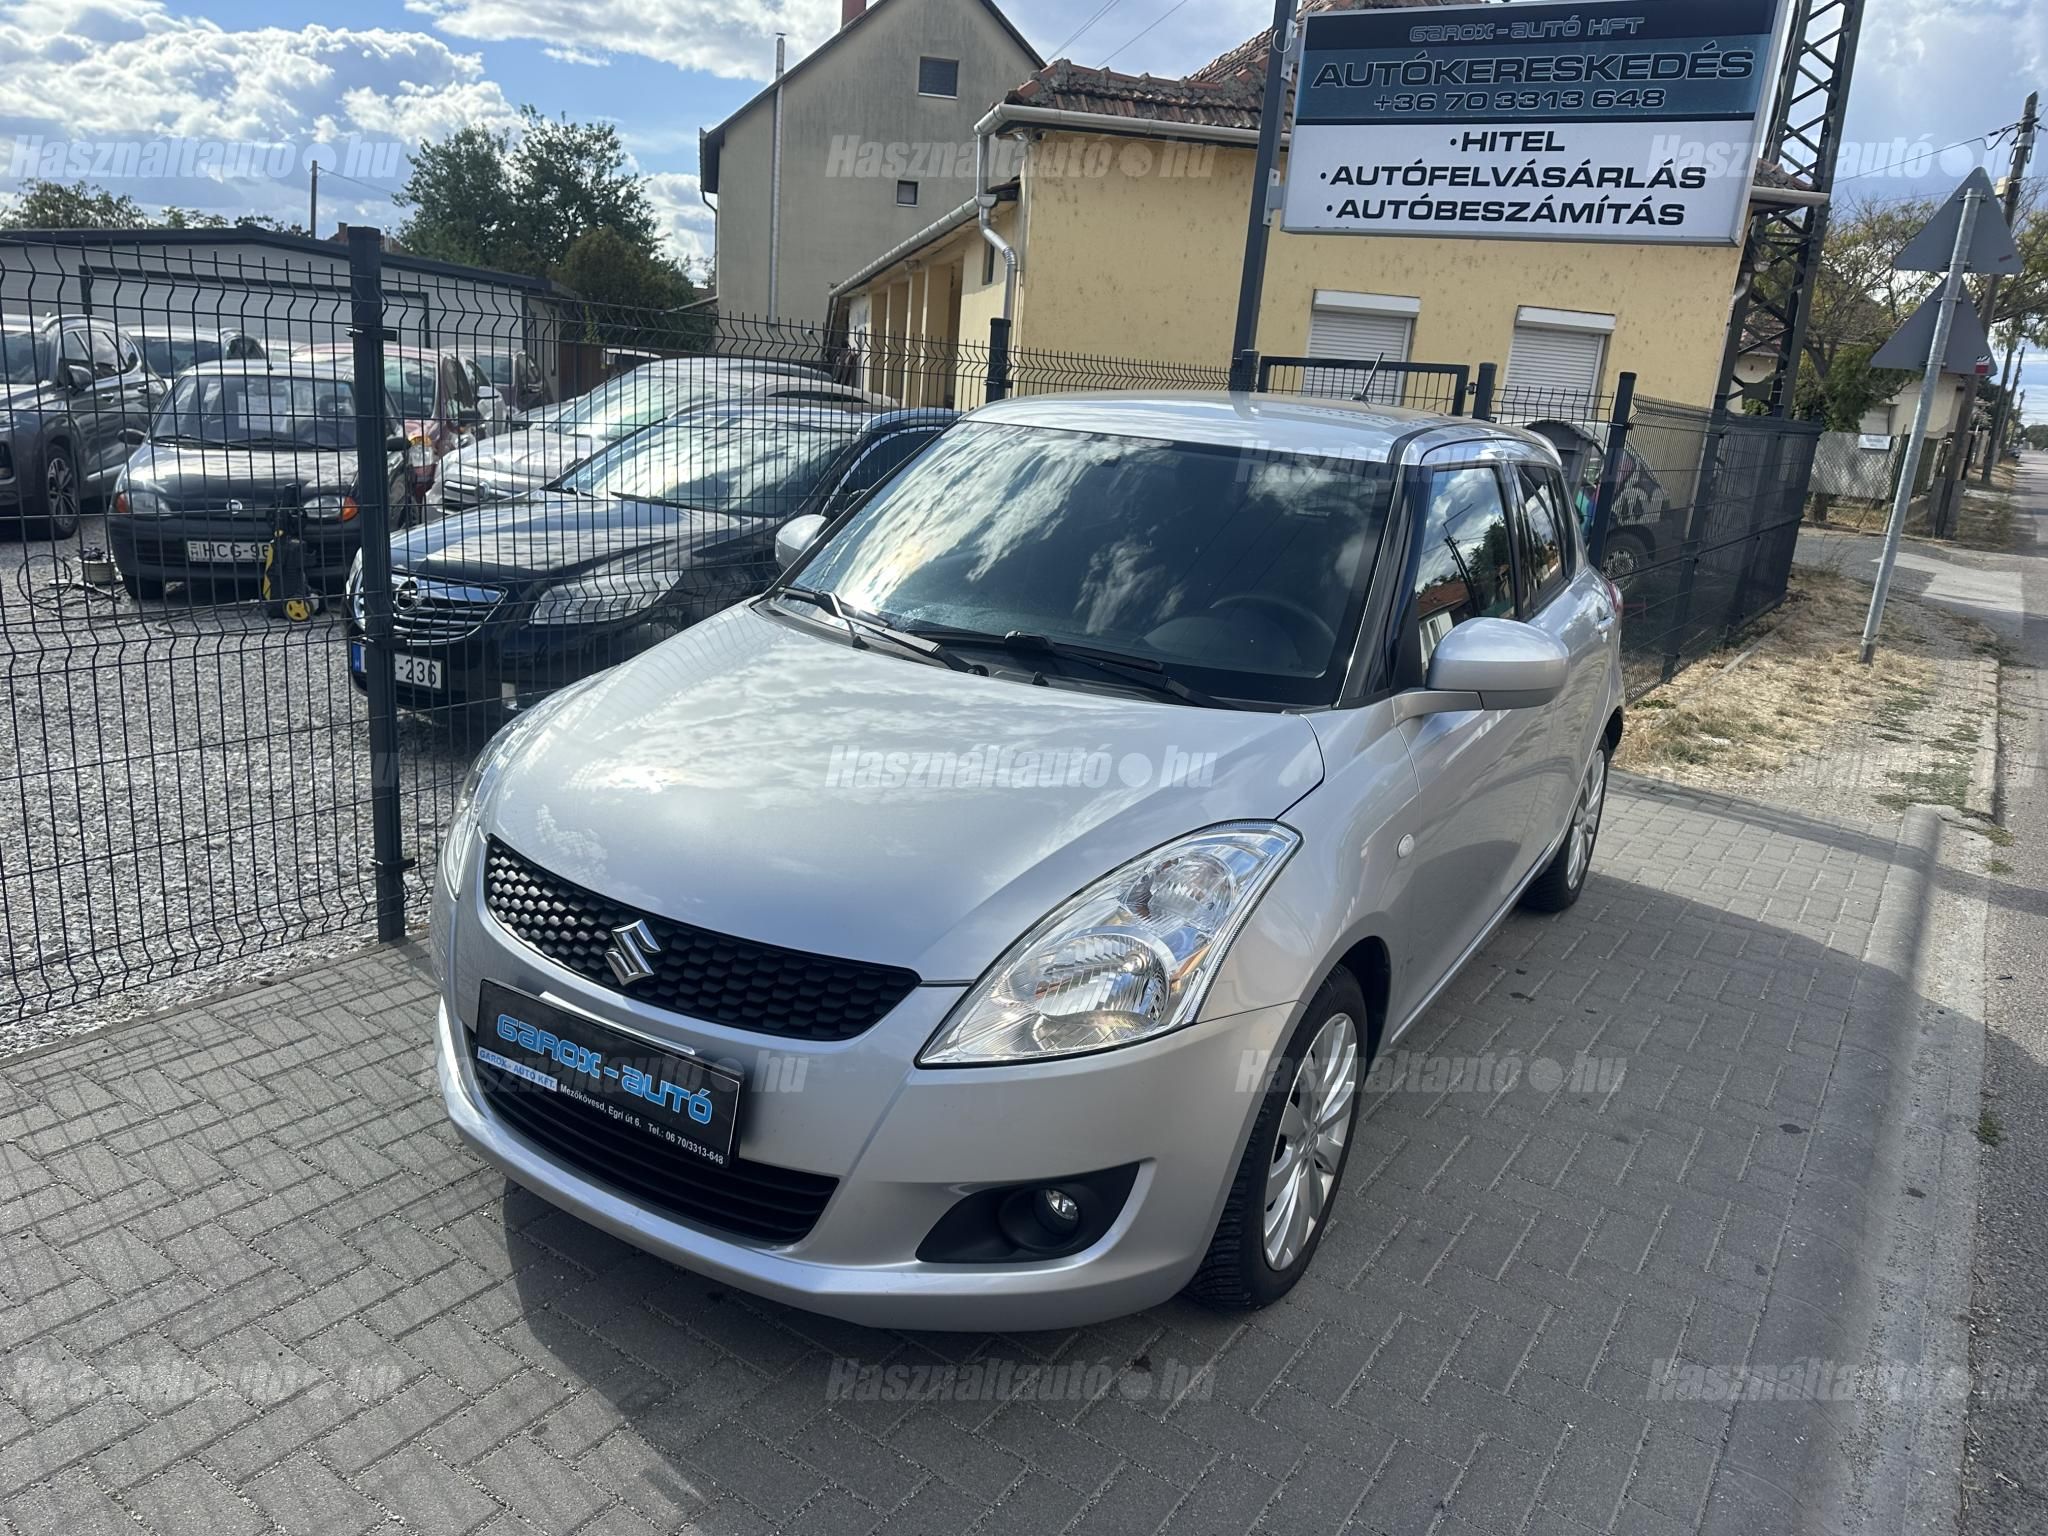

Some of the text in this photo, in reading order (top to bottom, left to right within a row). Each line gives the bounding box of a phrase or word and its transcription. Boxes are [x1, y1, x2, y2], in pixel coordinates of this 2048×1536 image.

[1311, 40, 1755, 89] AUTÓKERESKEDÉS
[1374, 88, 1666, 112] +36 70 3313 648
[1461, 131, 1565, 152] HITEL
[1330, 158, 1707, 189] AUTÓFELVÁSÁRLÁS
[1336, 192, 1685, 226] AUTÓBESZÁMÍTÁS
[608, 1105, 624, 1120] Egri
[665, 1131, 675, 1143] 06
[677, 1134, 724, 1165] 70/3313-648
